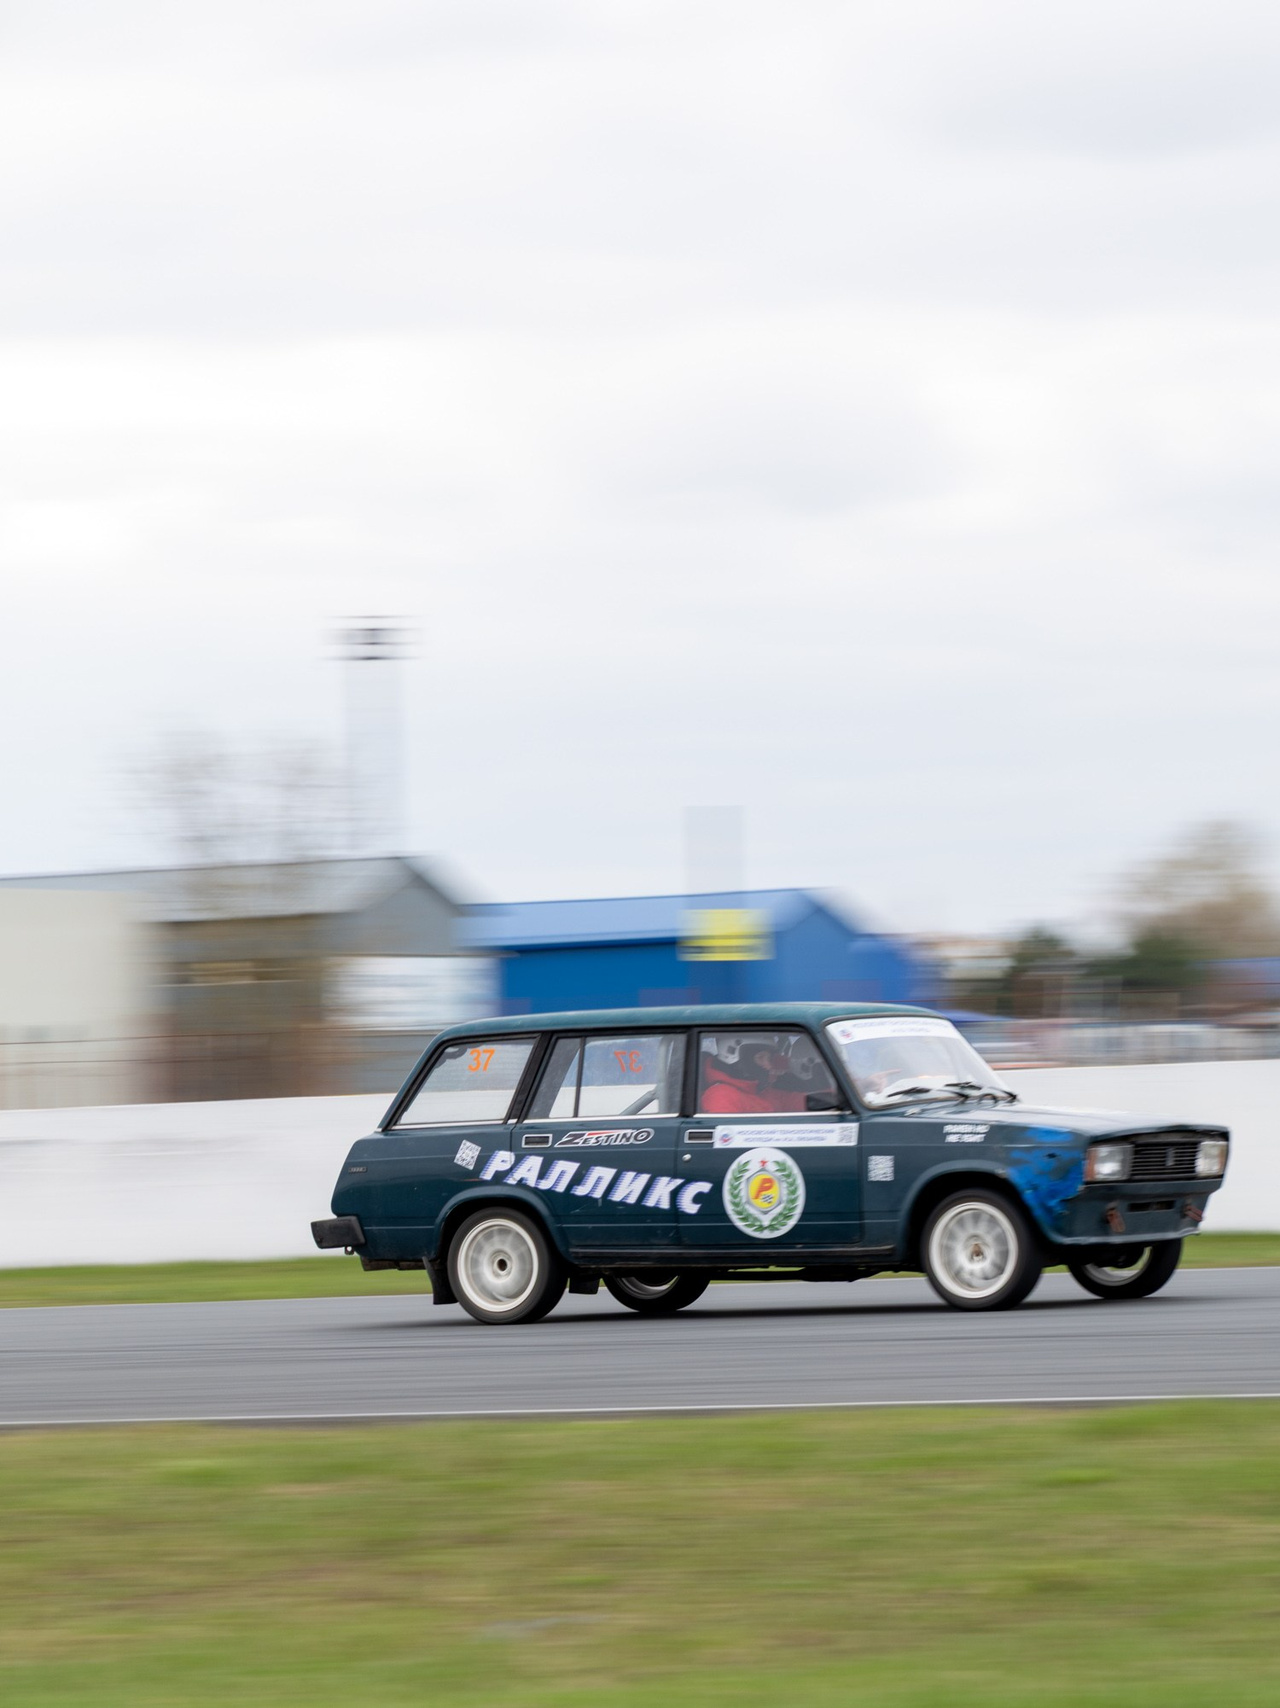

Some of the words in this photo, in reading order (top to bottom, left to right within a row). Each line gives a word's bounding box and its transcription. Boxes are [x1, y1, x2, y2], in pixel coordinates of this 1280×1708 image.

[467, 1048, 495, 1072] 37
[554, 1128, 655, 1147] ZESTINO
[479, 1150, 713, 1214] РАЛЛИКС
